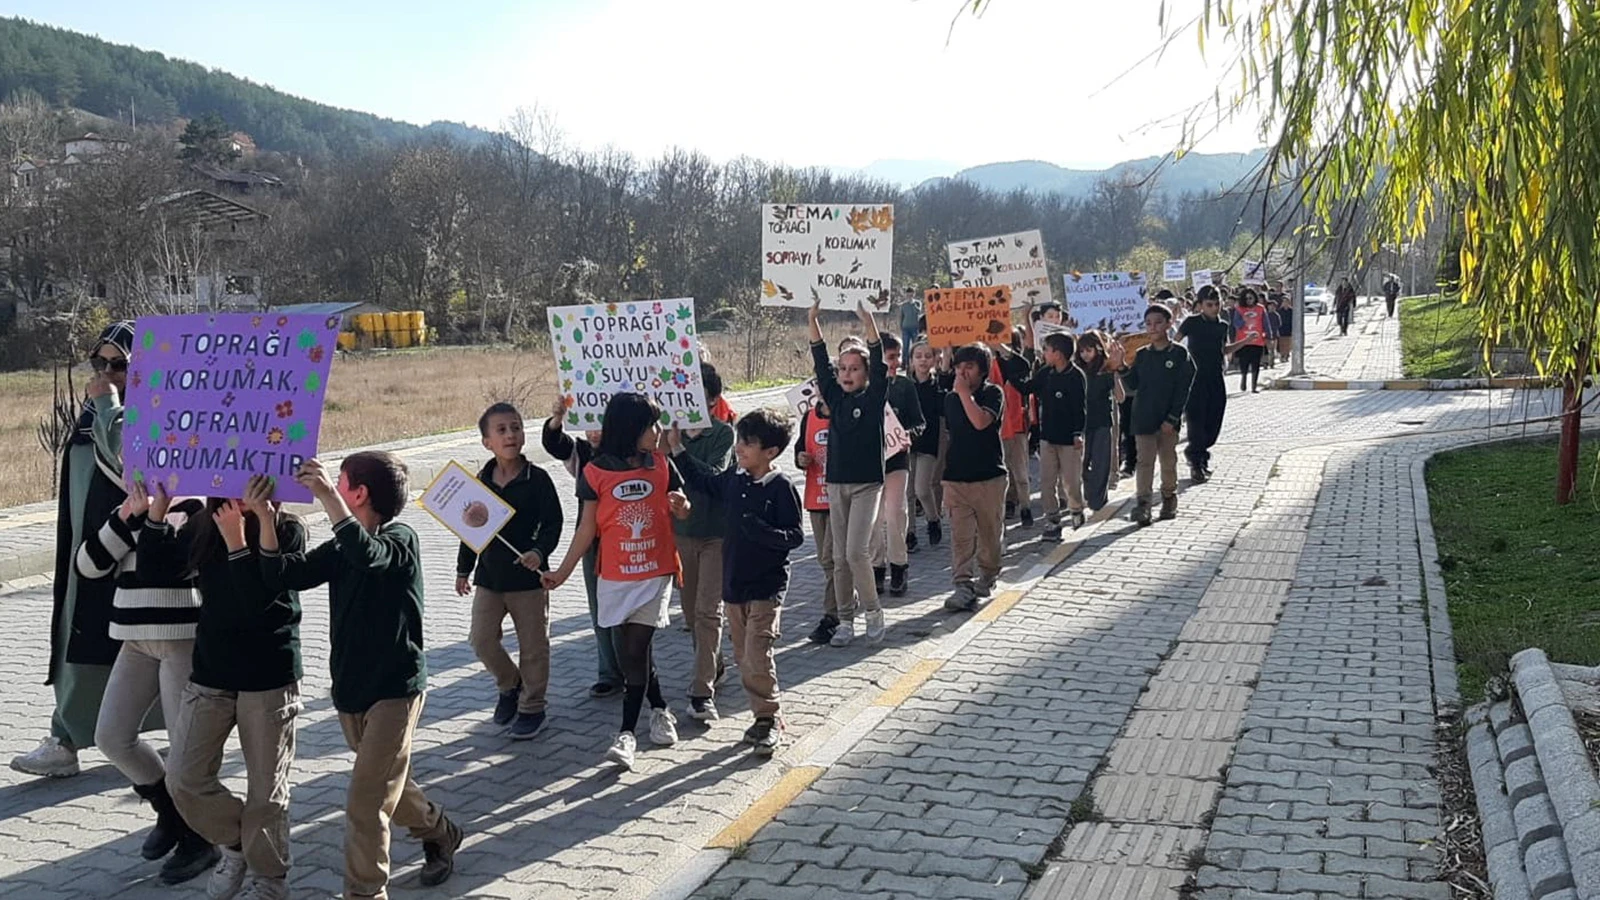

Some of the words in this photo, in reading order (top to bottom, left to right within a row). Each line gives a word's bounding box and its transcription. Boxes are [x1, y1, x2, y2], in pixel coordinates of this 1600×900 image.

[787, 205, 833, 220] TEMA
[825, 236, 877, 250] KORUMAK
[944, 291, 985, 301] TEMA
[580, 311, 661, 333] TOPRAĞI
[180, 329, 291, 357] TOPRAĞI
[582, 341, 674, 360] KORUMAK,
[164, 368, 299, 395] KORUMAK,
[601, 367, 649, 383] SUYU
[577, 392, 700, 409] KORKTIR.
[164, 409, 270, 434] SOFRANI
[146, 446, 304, 477] KORUMAKTIR
[620, 483, 642, 495] TEMA
